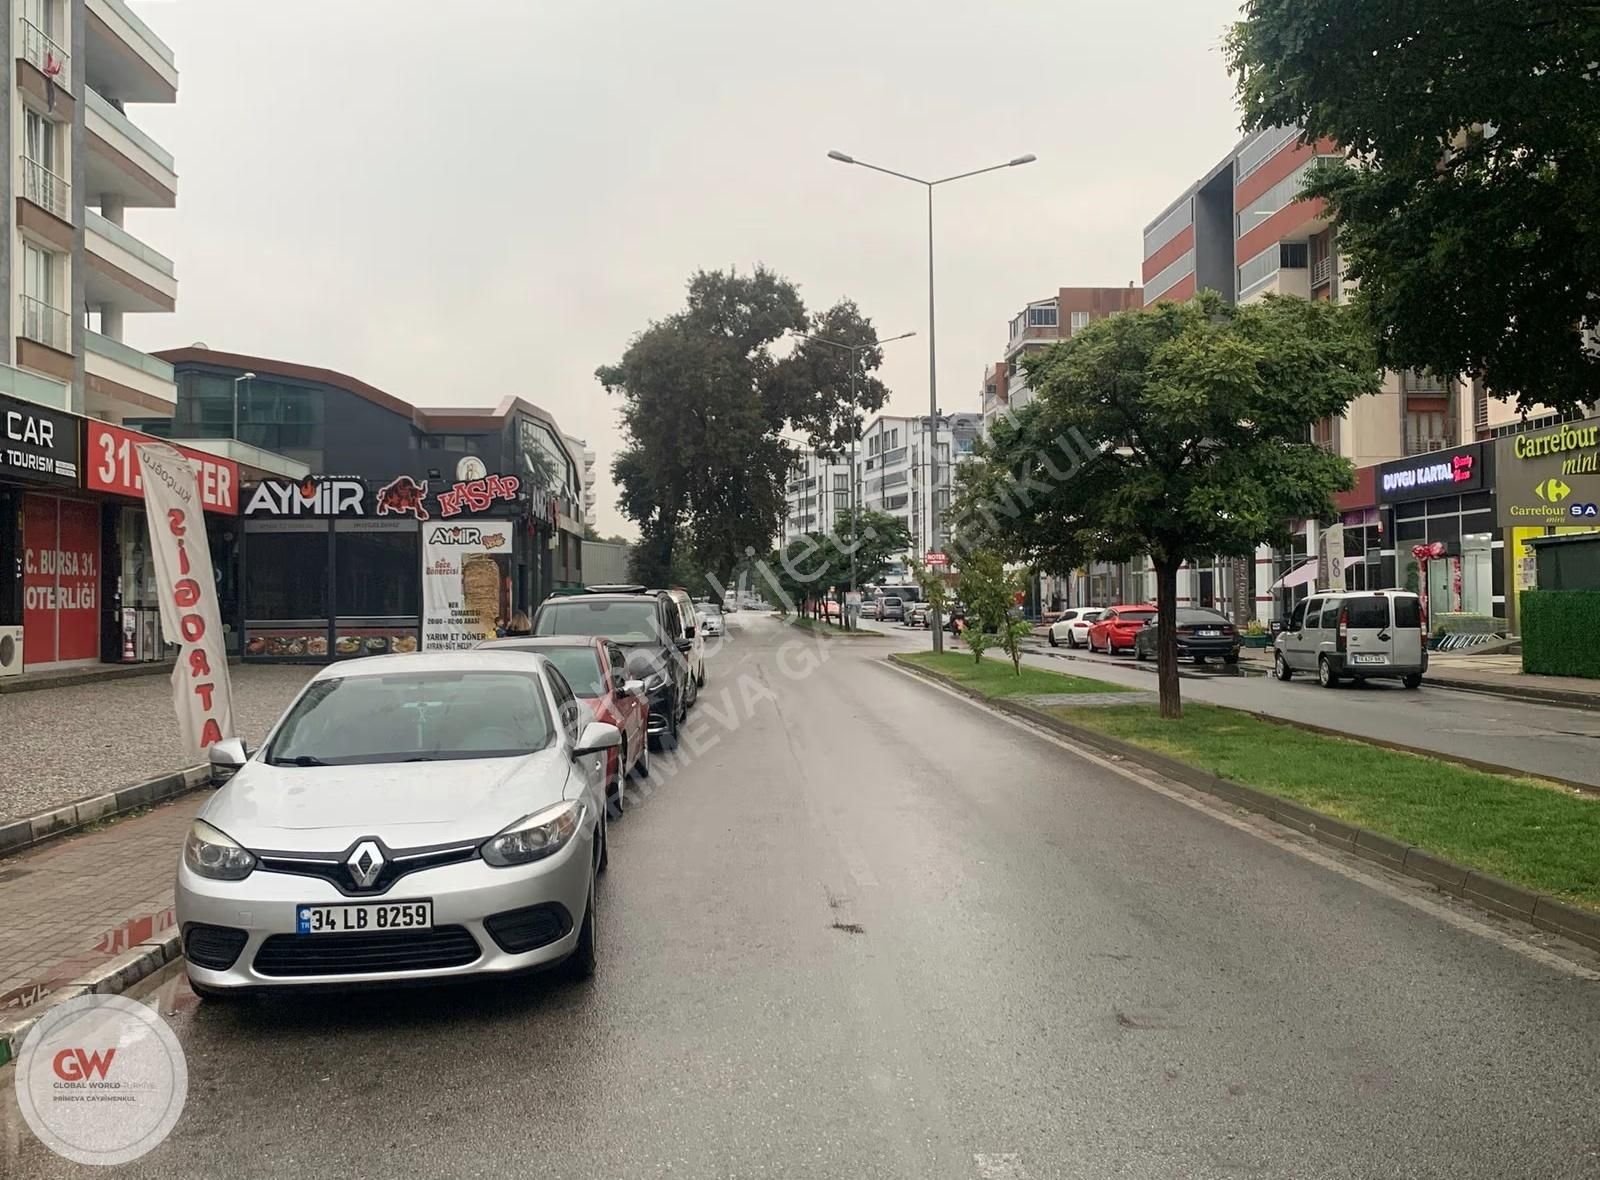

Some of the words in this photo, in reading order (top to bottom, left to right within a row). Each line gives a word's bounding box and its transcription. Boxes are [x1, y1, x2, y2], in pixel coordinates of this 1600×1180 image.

[7, 411, 54, 448] CAR
[1514, 424, 1598, 459] Carrefour
[7, 450, 54, 473] TOURISM
[1562, 451, 1598, 475] mini
[1383, 469, 1416, 490] DUYGU
[1416, 463, 1453, 484] KARTAL
[437, 475, 520, 517] KASAP
[1510, 504, 1566, 516] Carrefour
[40, 549, 79, 575] BURSA
[81, 552, 97, 576] 31.
[24, 582, 95, 610] OTERLİĞİ
[426, 633, 449, 641] YARIM
[462, 631, 486, 640] DÖNER
[312, 909, 336, 931] 34
[344, 908, 368, 930] LB
[376, 905, 427, 928] 8259
